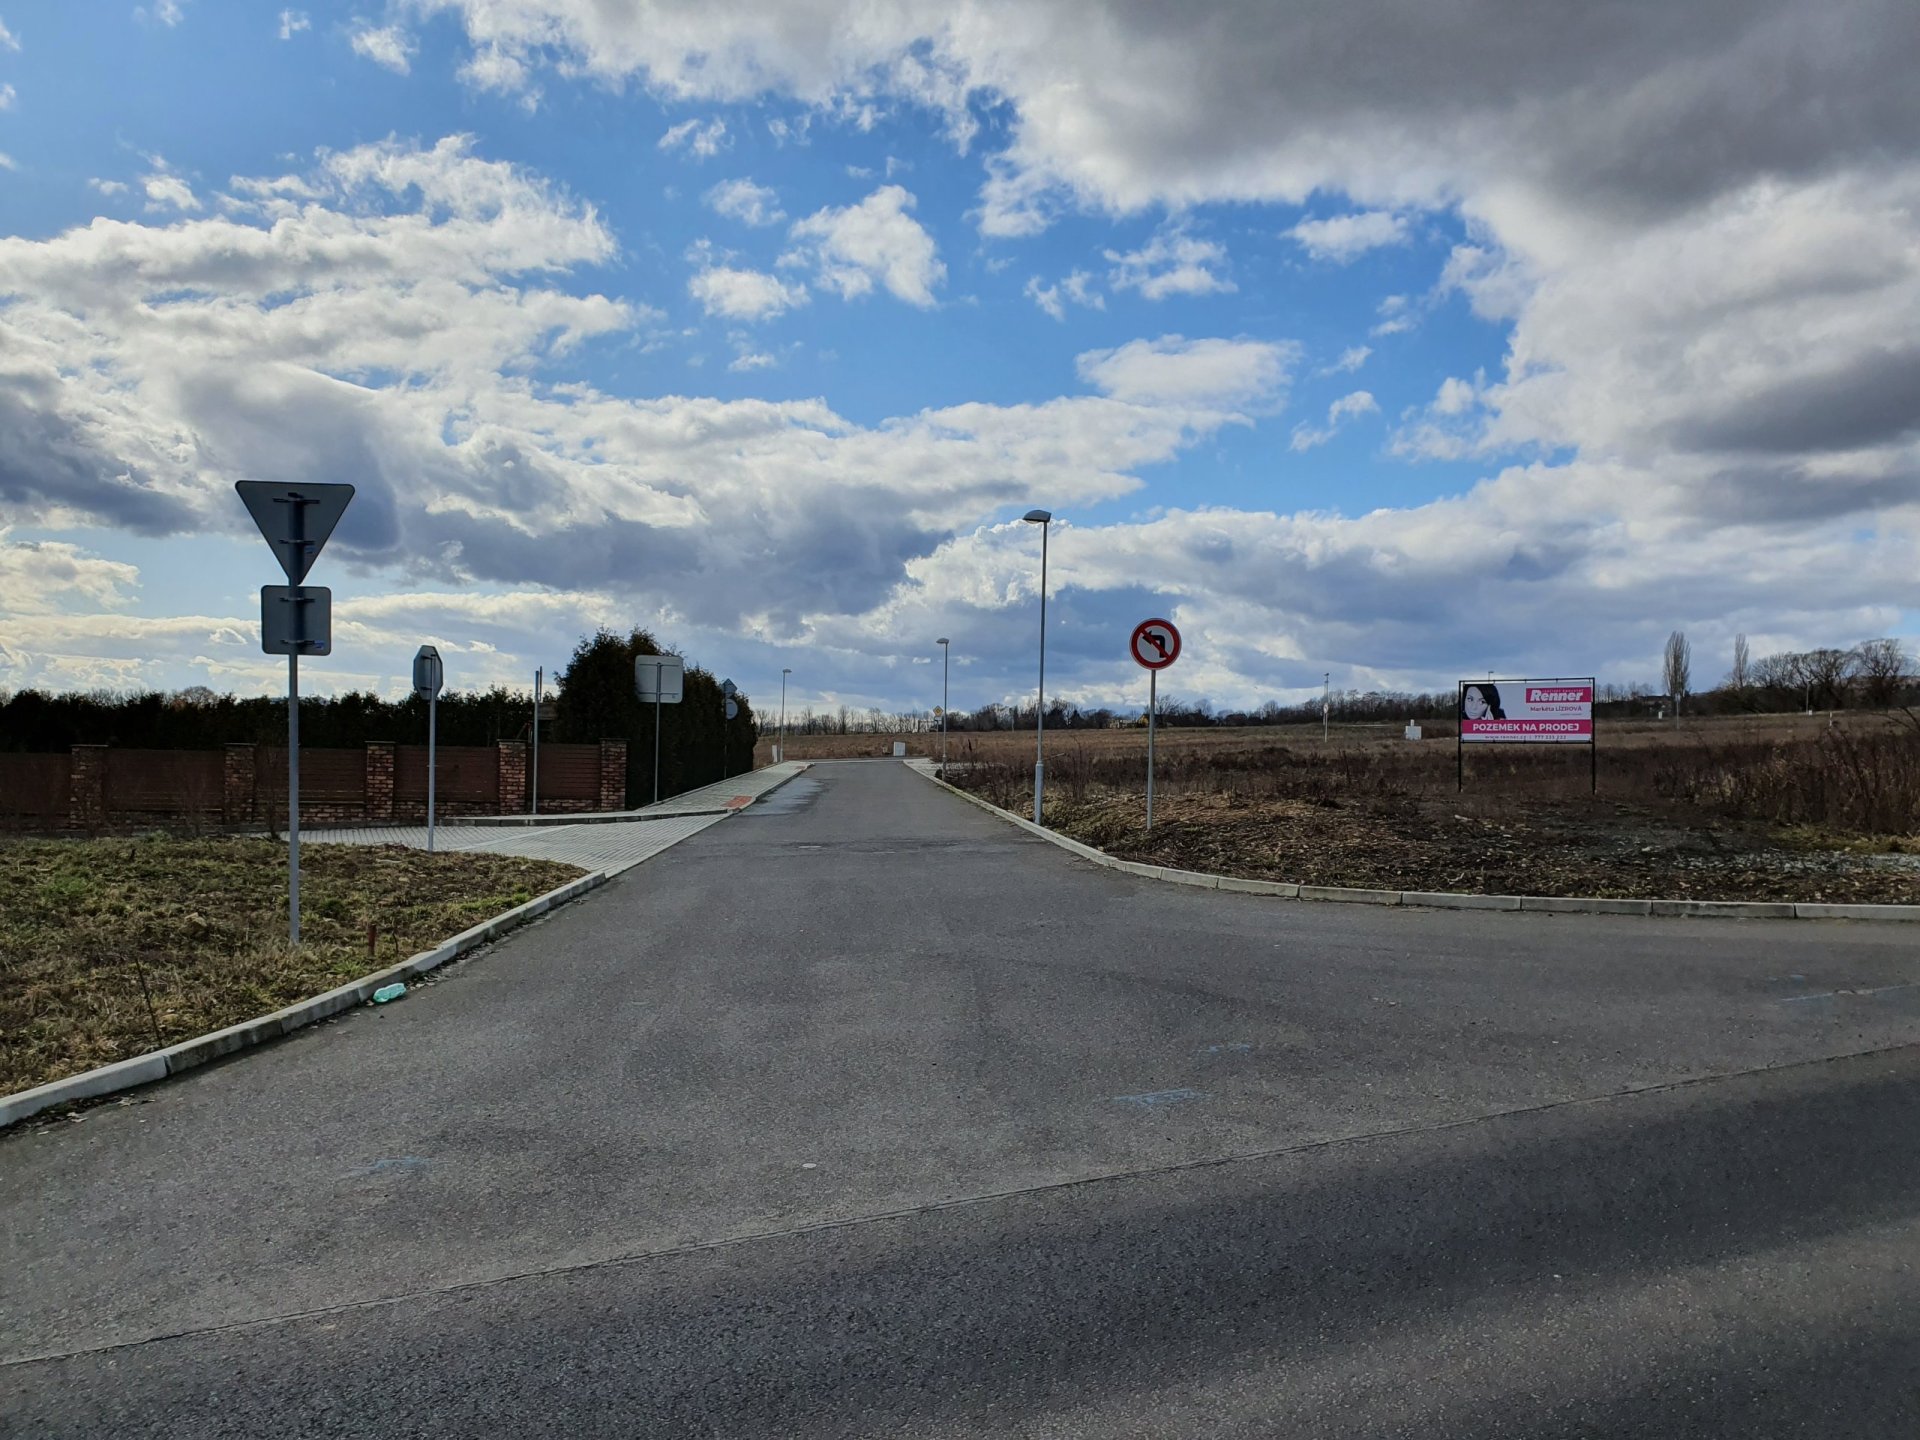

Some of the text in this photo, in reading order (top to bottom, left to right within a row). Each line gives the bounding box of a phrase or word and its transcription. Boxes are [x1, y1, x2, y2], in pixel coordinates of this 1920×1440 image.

[1530, 689, 1583, 701] Renner
[1472, 723, 1579, 731] POZEMEK NA PRODEJ
